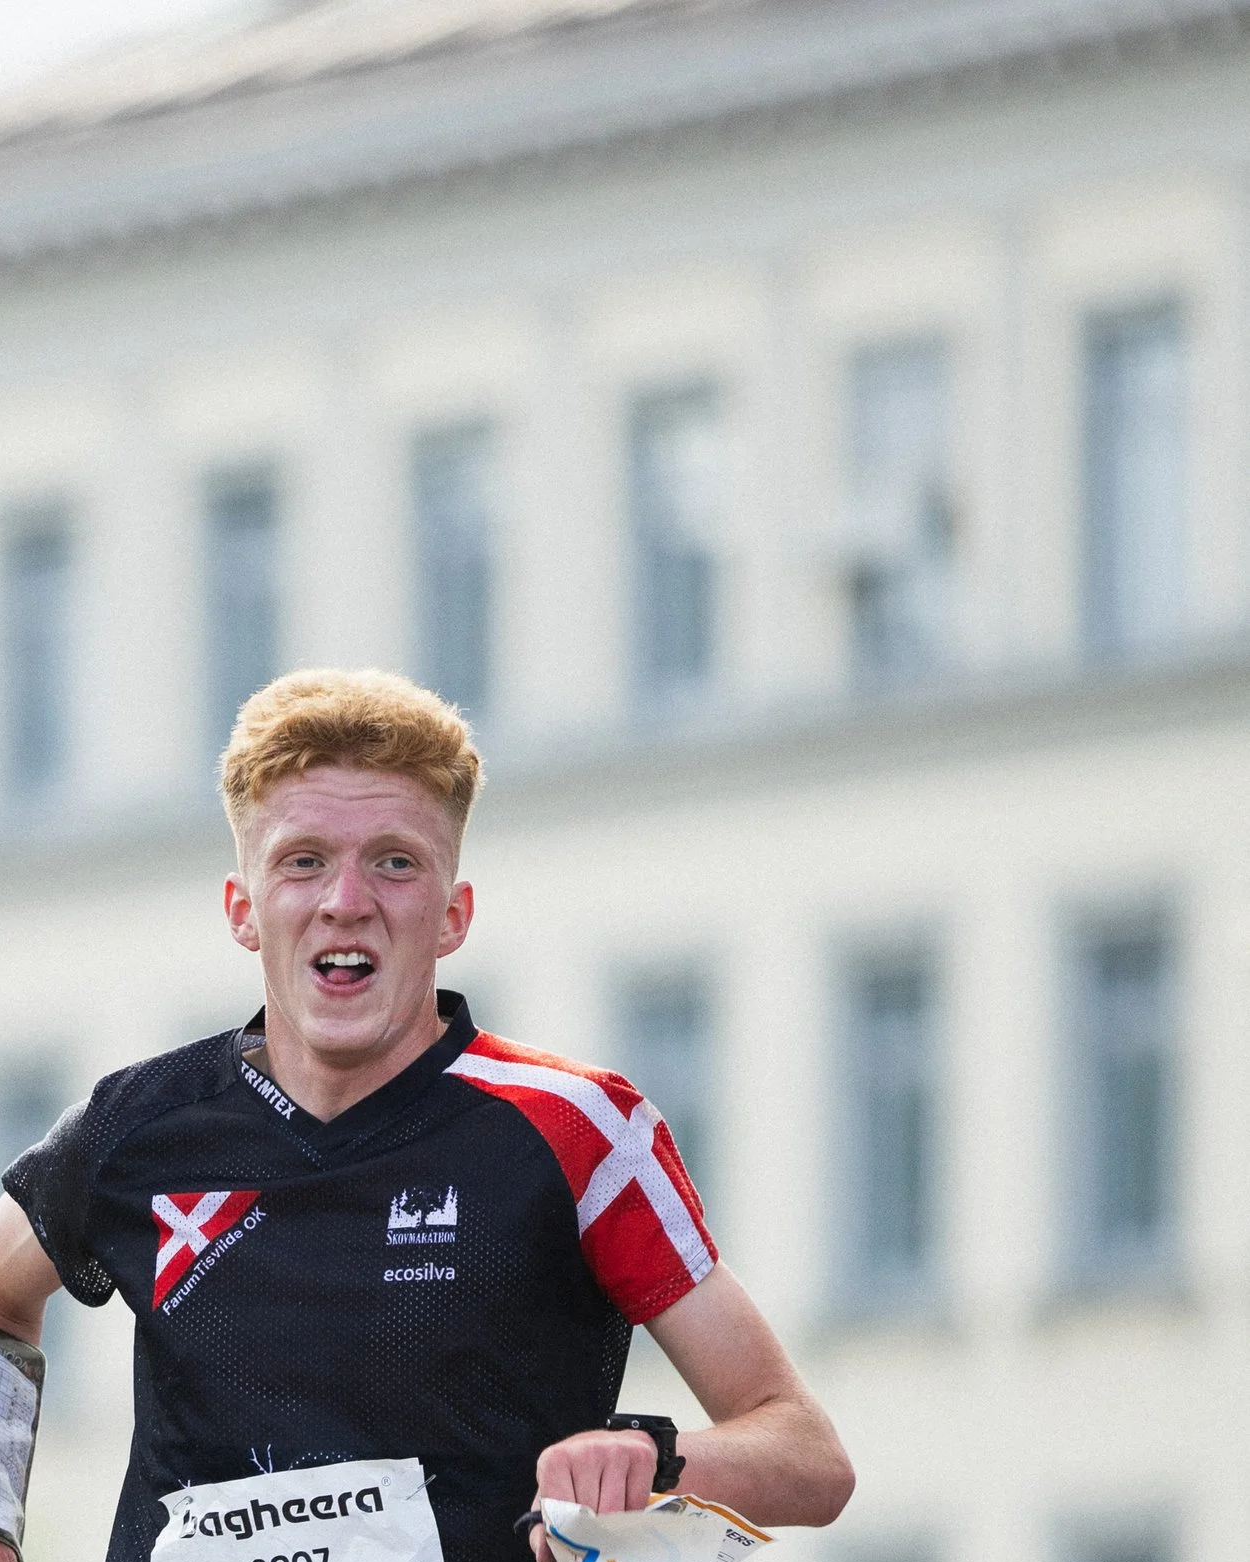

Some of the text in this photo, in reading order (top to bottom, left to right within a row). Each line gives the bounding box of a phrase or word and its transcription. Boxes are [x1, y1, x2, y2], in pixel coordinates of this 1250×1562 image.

[241, 1061, 297, 1120] TRIMTEX
[244, 1206, 267, 1229] OK
[384, 1262, 455, 1281] ecosilva
